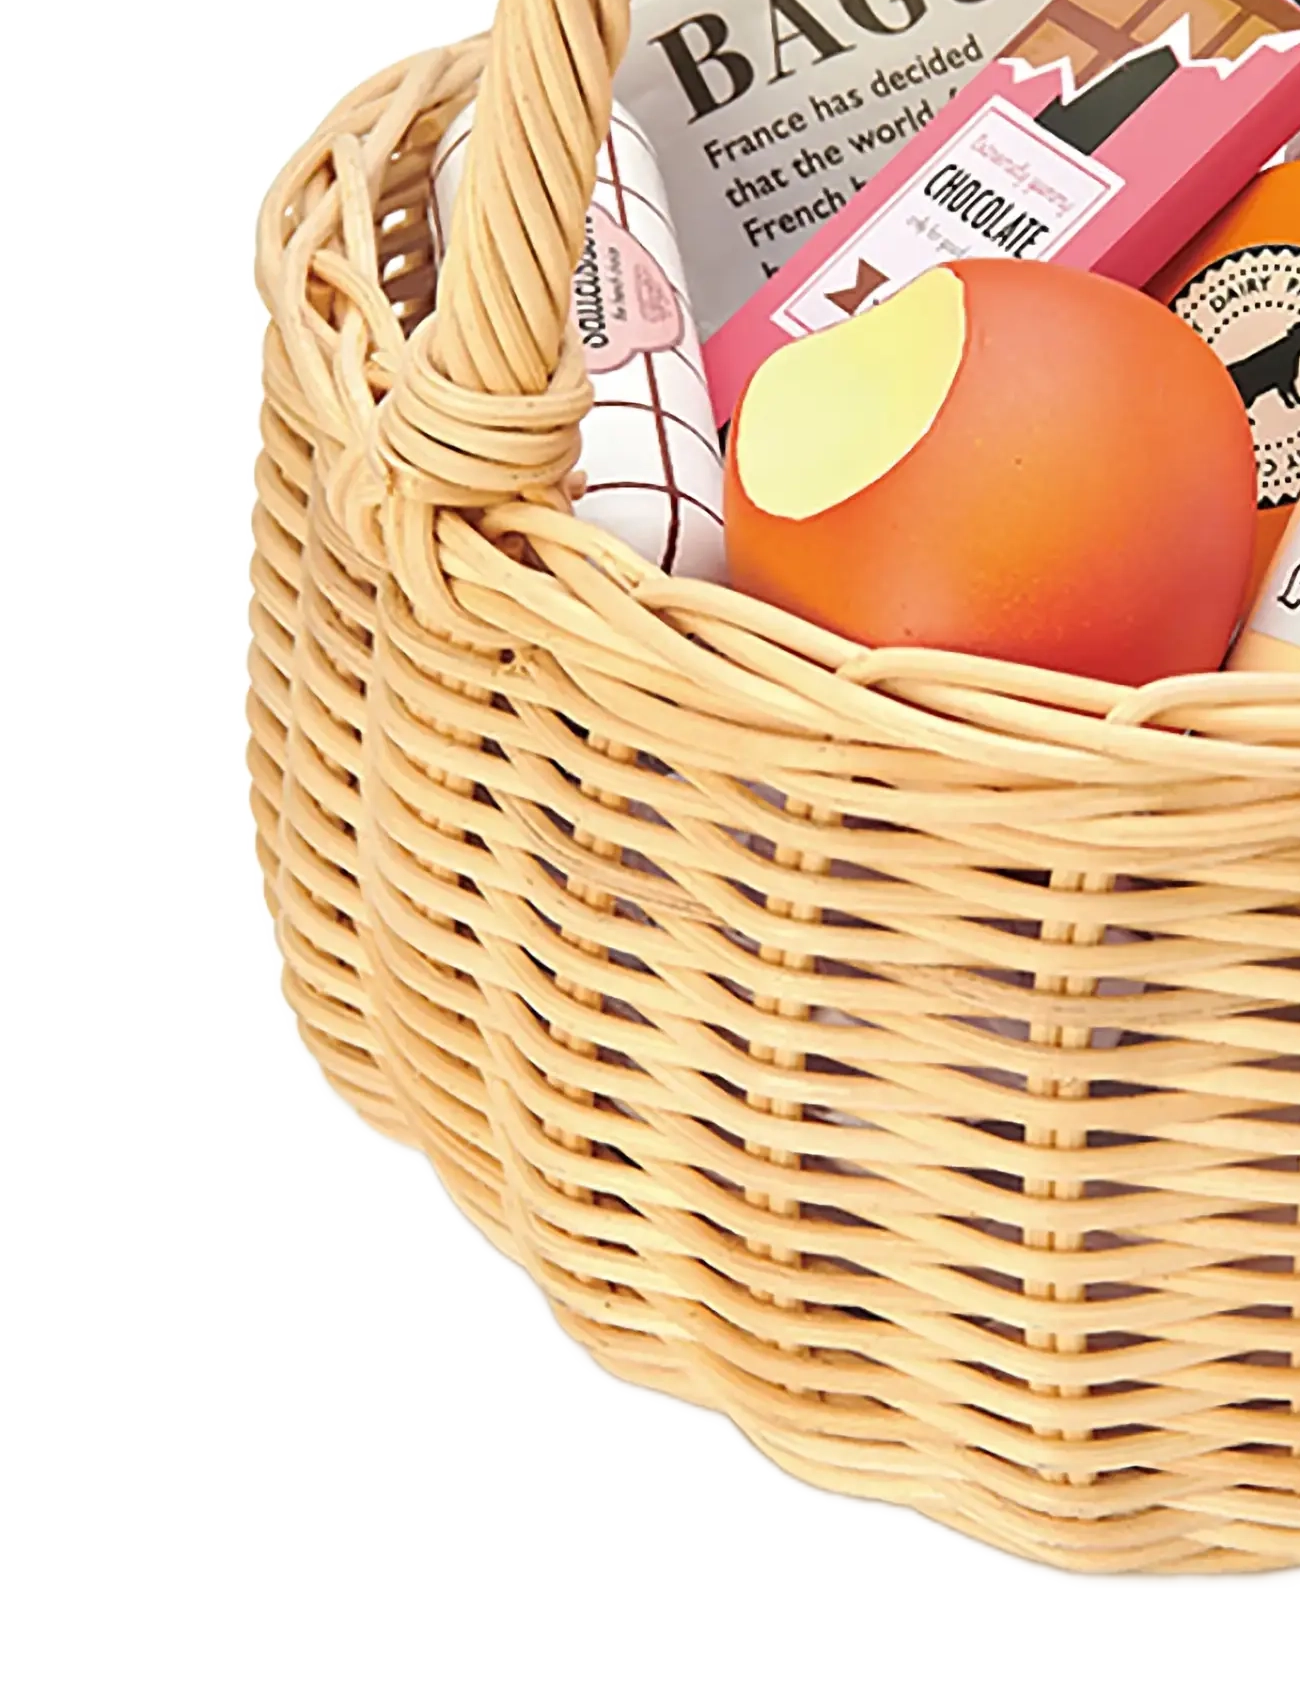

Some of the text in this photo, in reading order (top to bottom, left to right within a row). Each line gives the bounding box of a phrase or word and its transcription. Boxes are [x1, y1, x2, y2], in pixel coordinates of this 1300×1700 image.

[704, 33, 984, 170] France has decided
[725, 99, 935, 208] that the world
[743, 187, 847, 248] French
[924, 163, 1050, 259] CHOCOLATE
[1209, 275, 1274, 314] DAIRY
